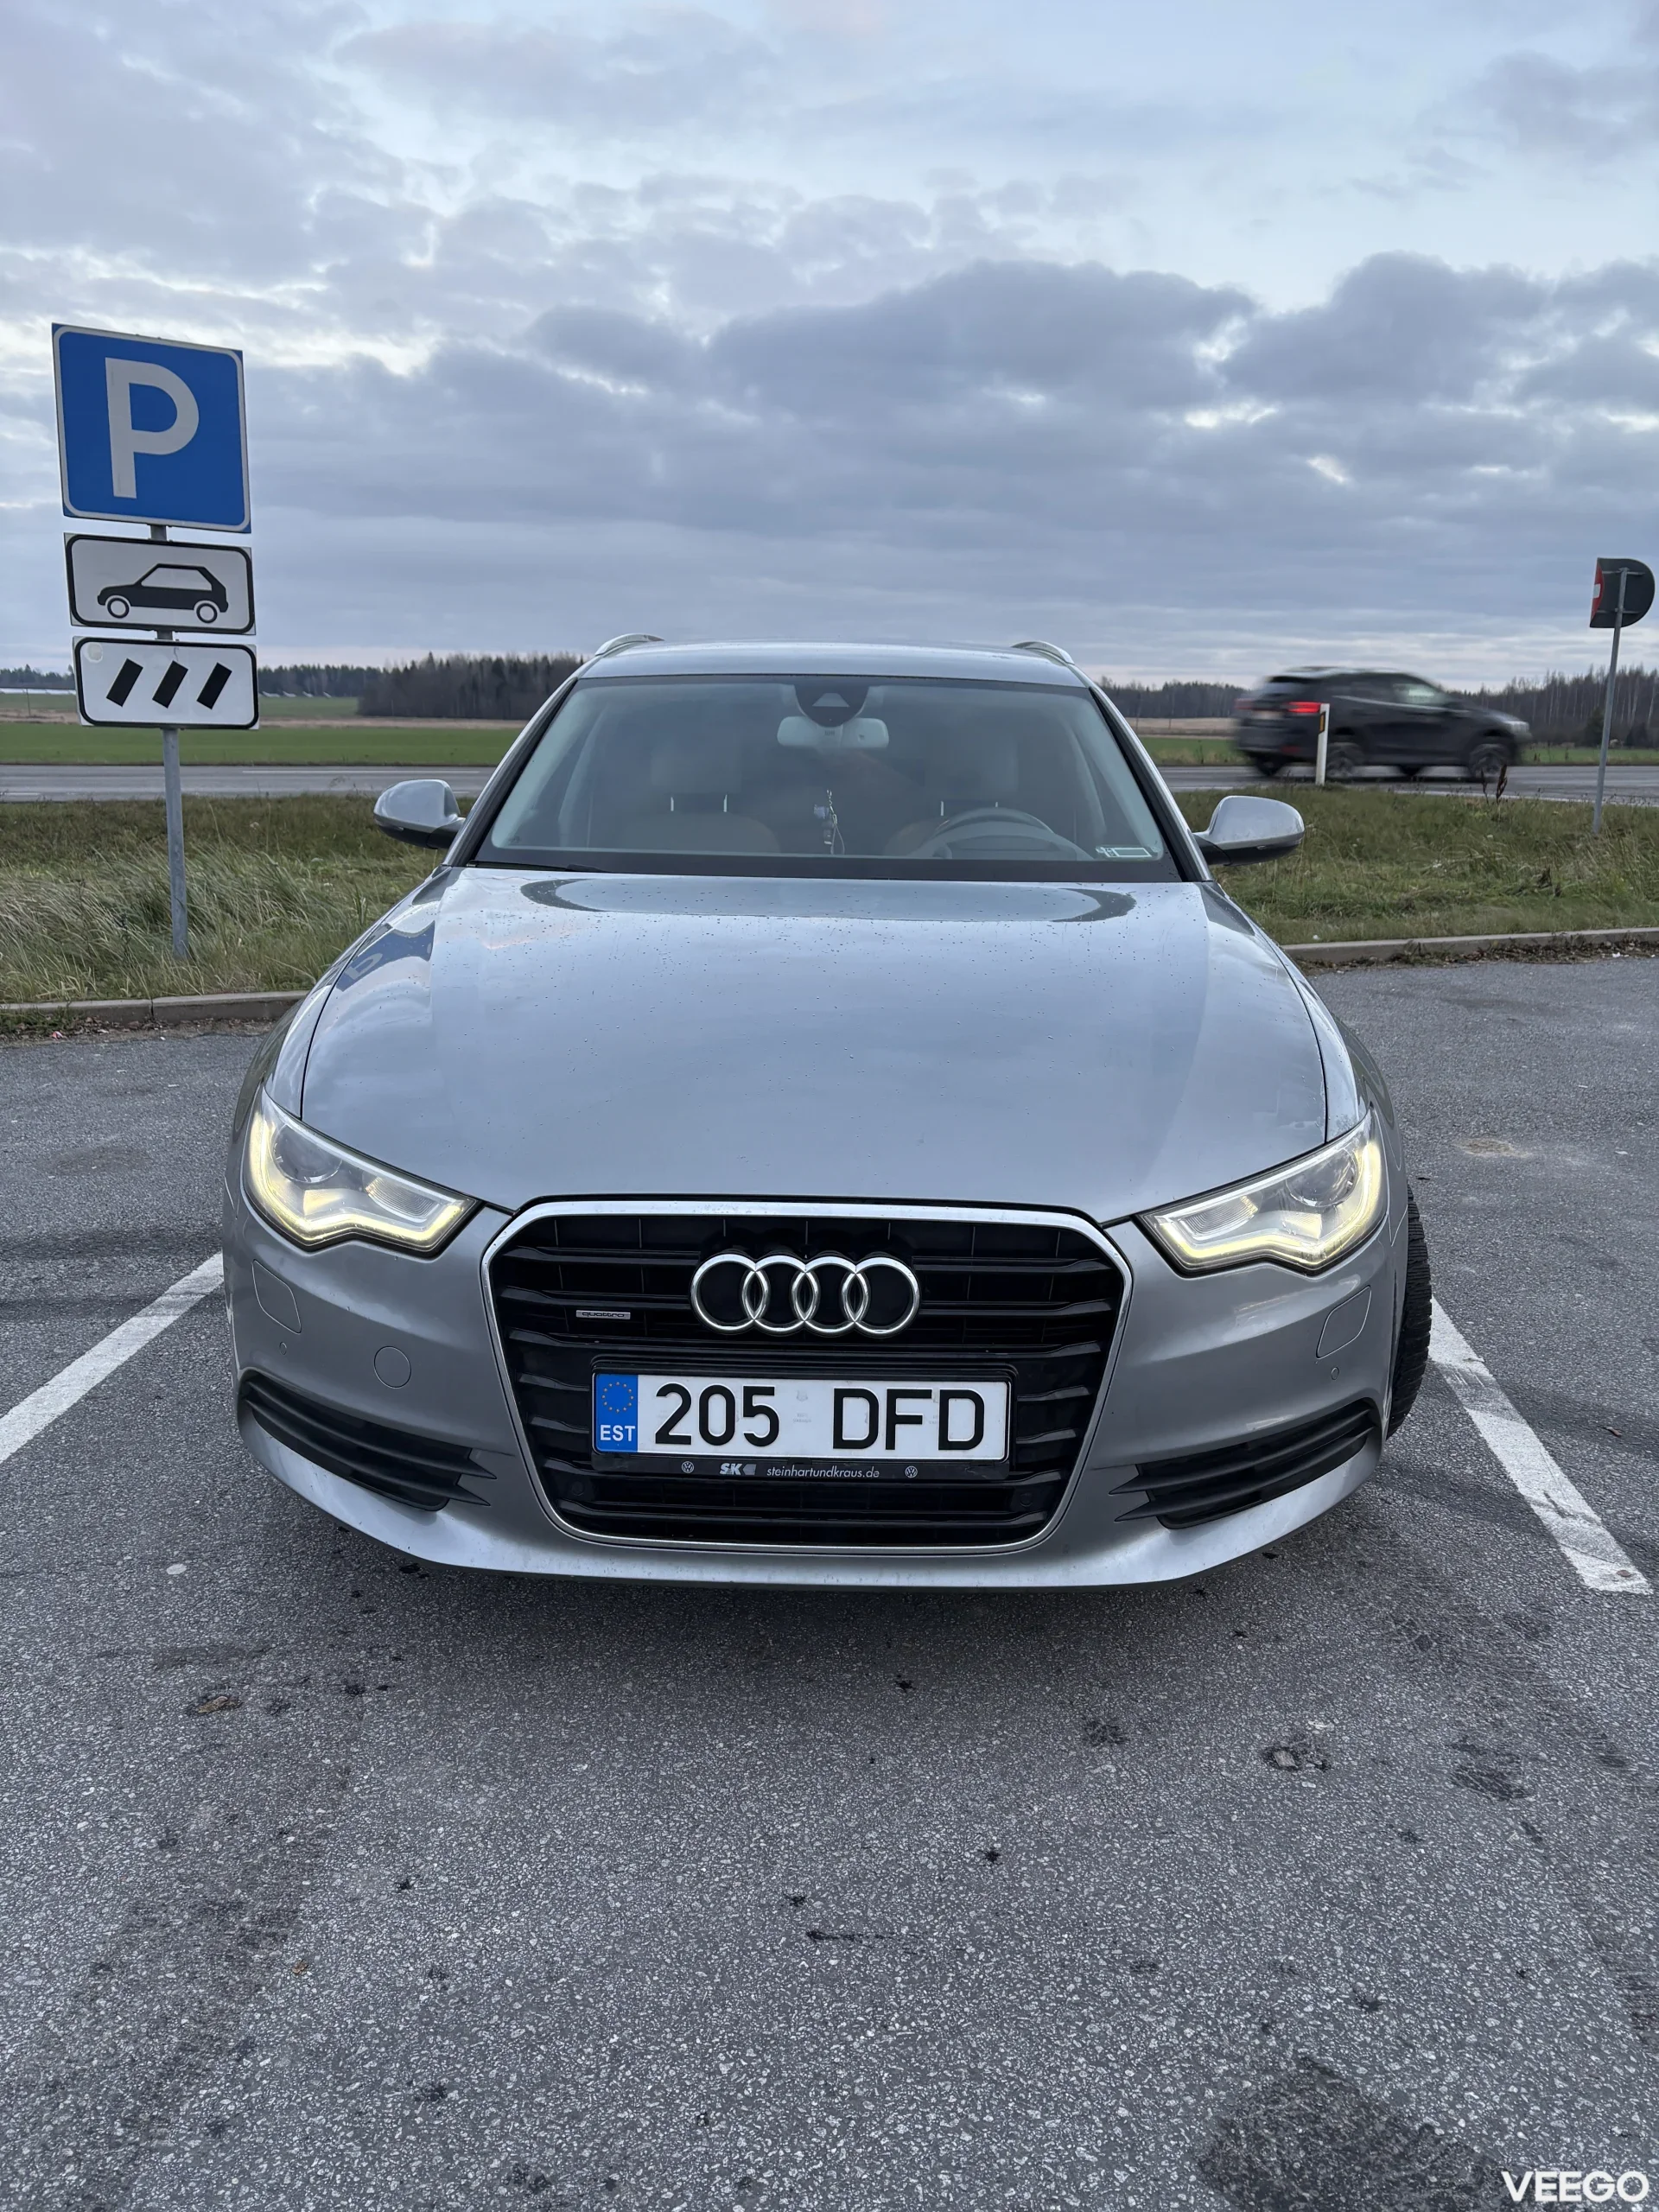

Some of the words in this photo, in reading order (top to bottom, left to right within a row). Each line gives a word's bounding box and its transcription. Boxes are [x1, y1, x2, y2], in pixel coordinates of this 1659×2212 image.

[105, 358, 199, 499] P
[655, 1382, 779, 1447] 205
[833, 1388, 985, 1451] DFD
[600, 1424, 636, 1441] EST
[720, 1463, 742, 1476] SK
[766, 1465, 880, 1478] steinhartundkraus.de
